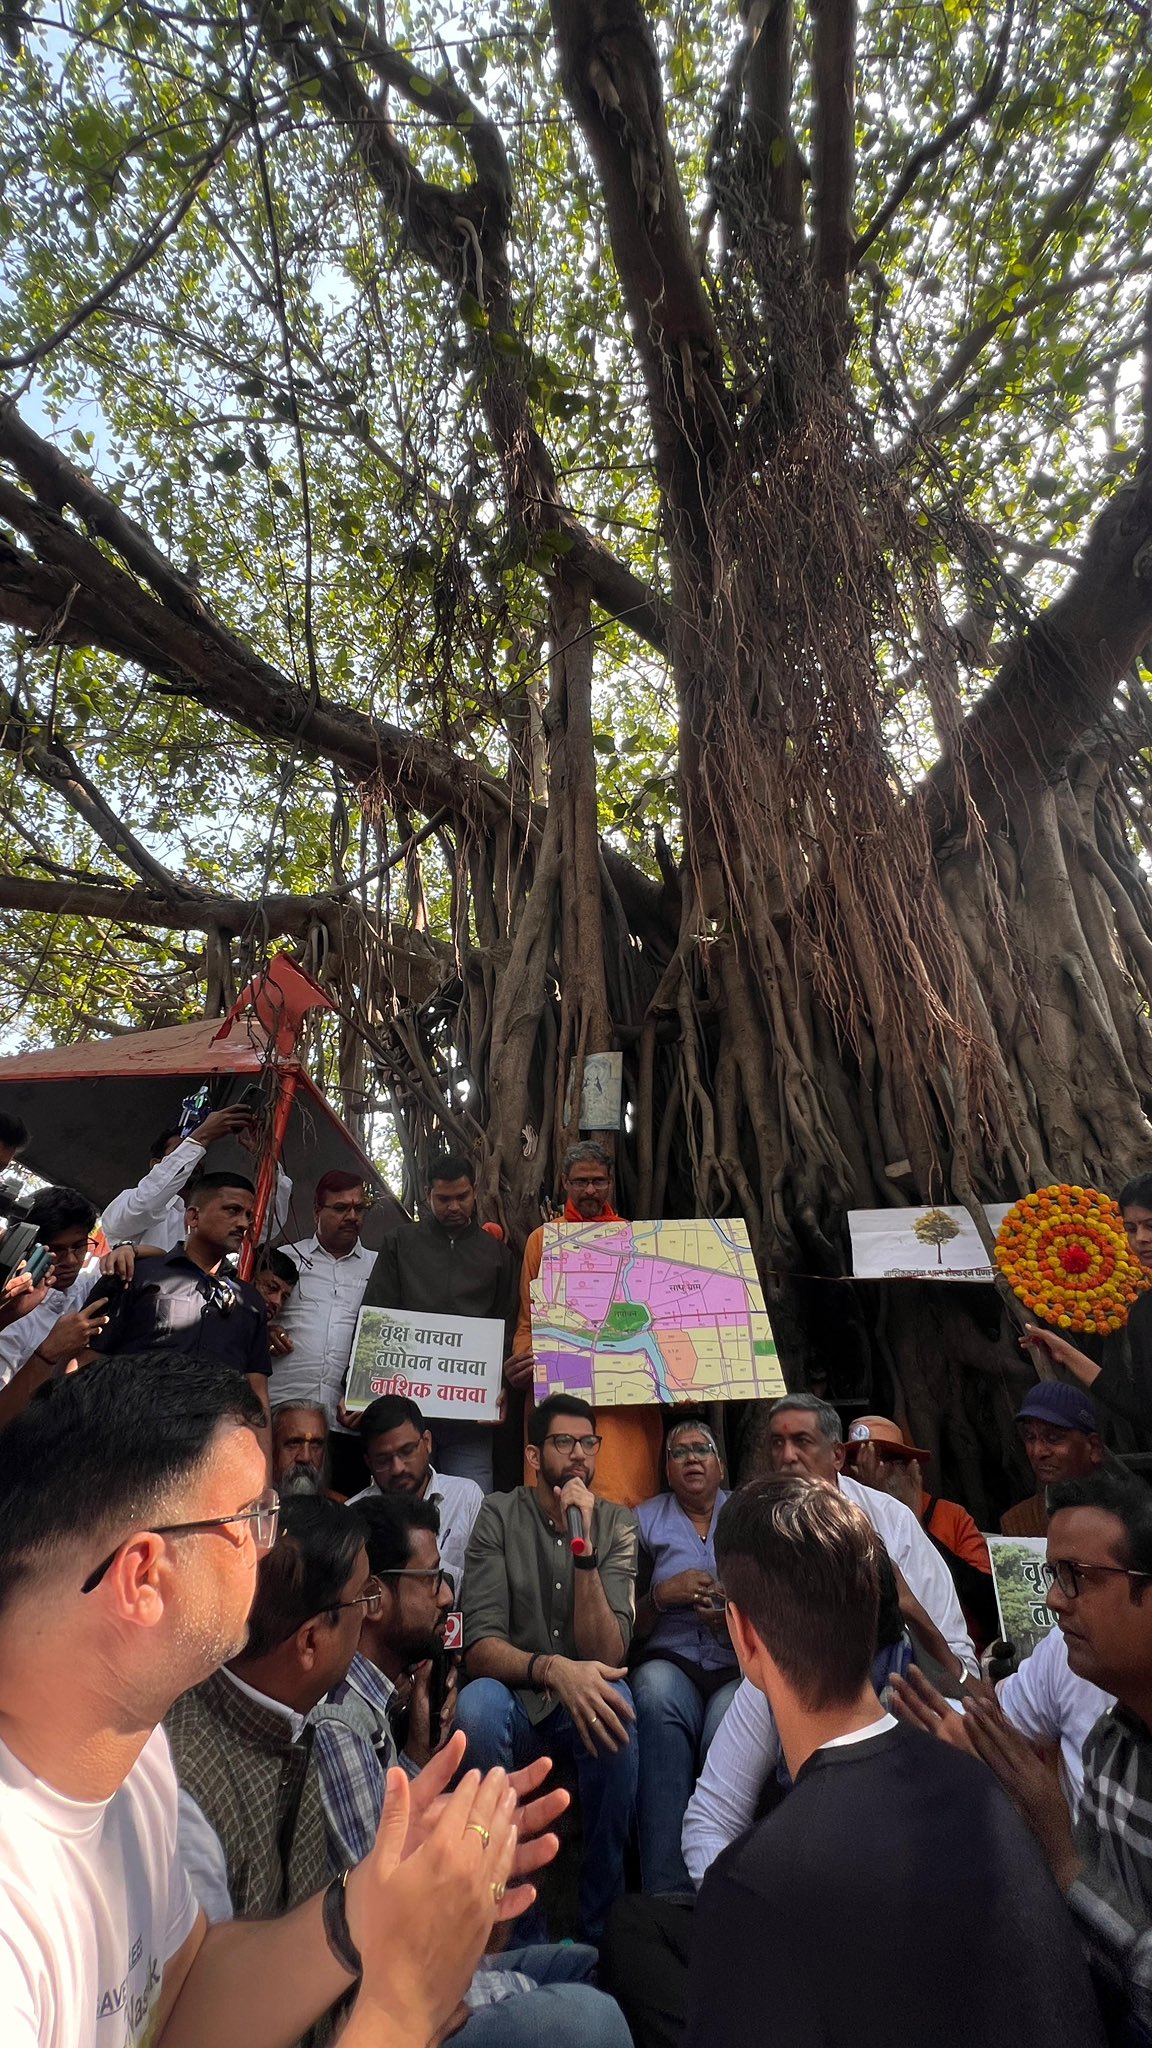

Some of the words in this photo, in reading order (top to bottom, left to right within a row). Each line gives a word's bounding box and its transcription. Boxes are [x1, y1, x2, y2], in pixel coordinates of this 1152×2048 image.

[381, 1324, 410, 1346] वृक्ष
[415, 1328, 463, 1347] वाचवा
[376, 1347, 433, 1371] तपोवन
[438, 1357, 487, 1376] वाचवा
[371, 1373, 432, 1398] नाशिक
[437, 1384, 488, 1404] वाचवा
